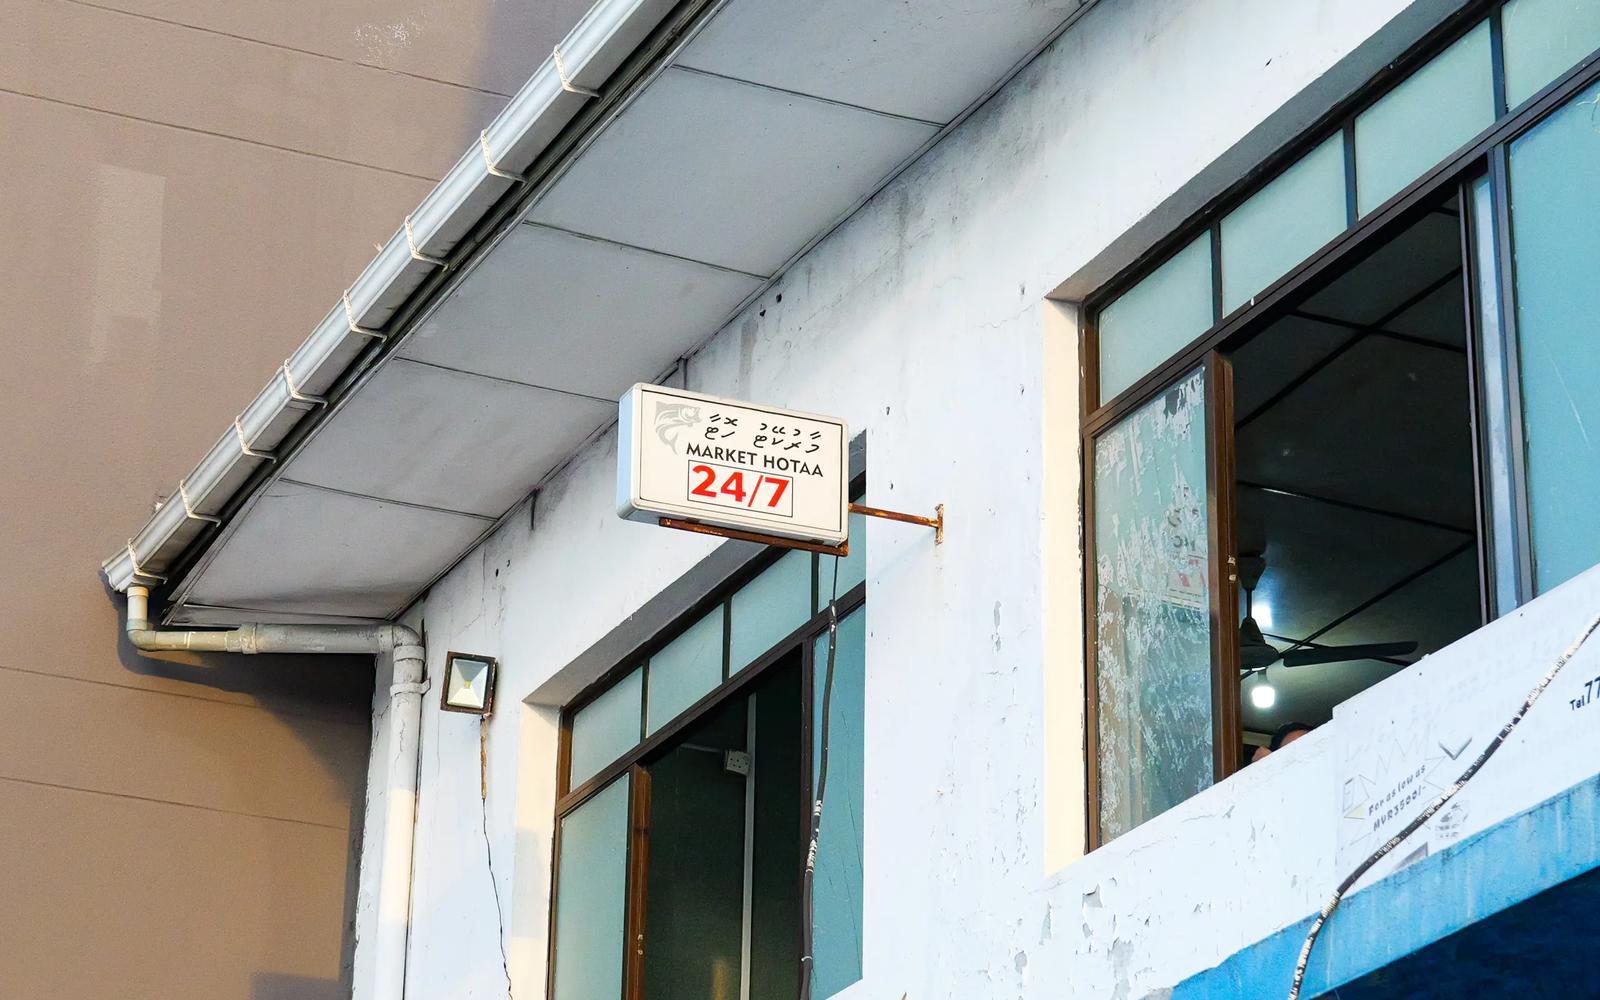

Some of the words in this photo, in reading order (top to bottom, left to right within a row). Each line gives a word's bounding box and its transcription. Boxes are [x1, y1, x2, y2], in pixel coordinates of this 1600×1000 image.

[686, 442, 758, 466] MARKET
[763, 455, 823, 477] HOTAA
[690, 465, 789, 508] 24/7
